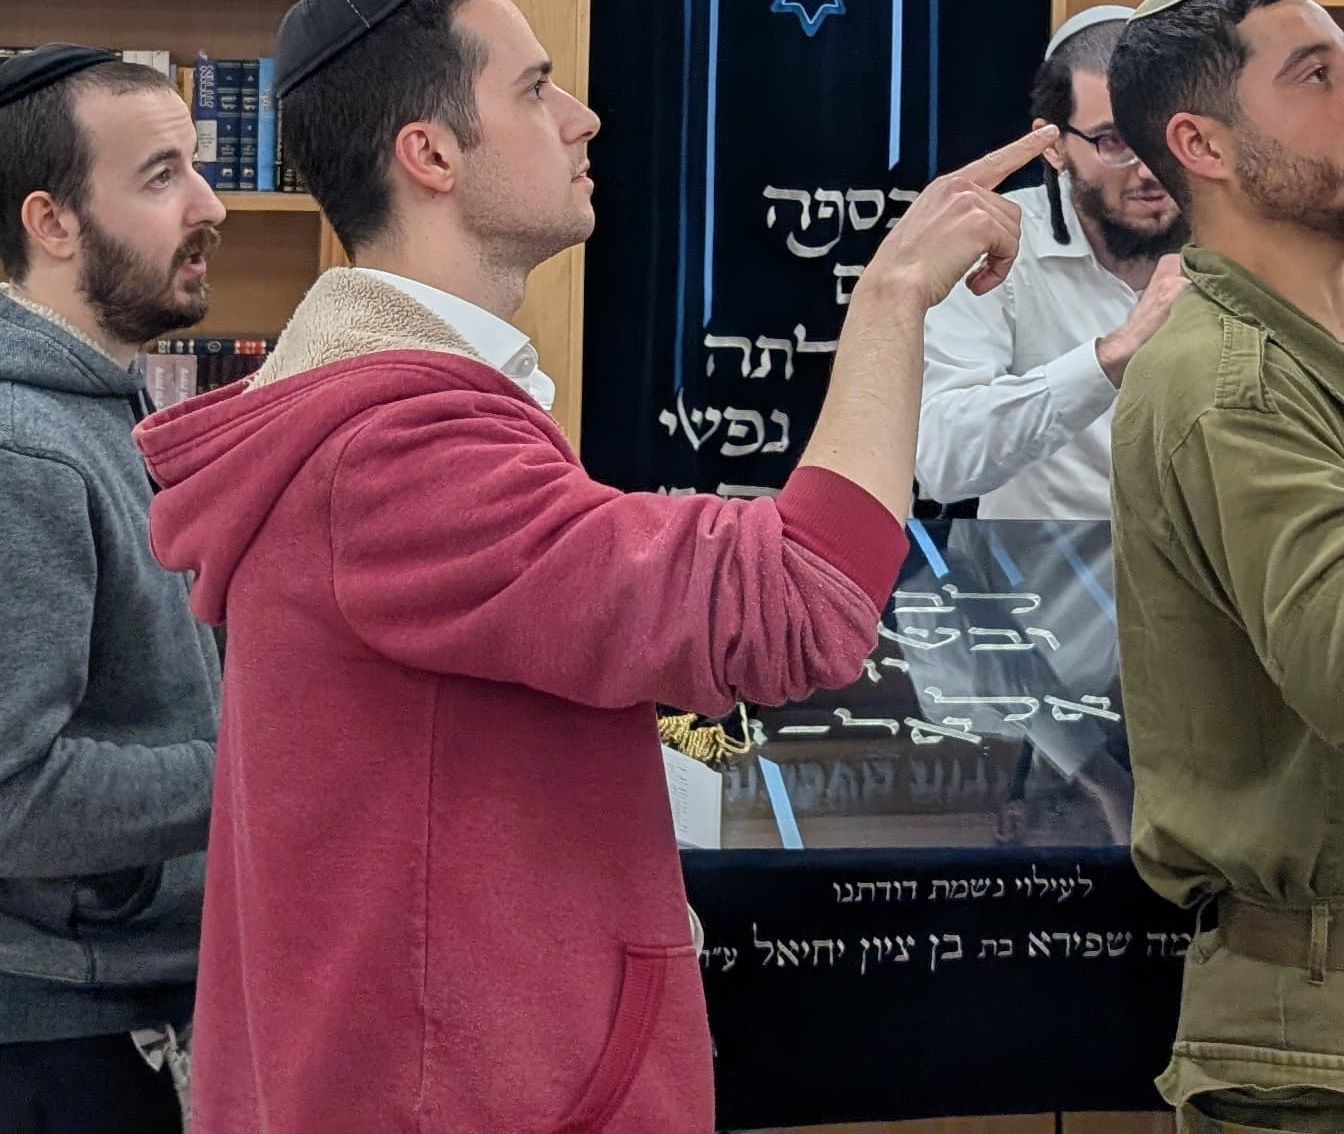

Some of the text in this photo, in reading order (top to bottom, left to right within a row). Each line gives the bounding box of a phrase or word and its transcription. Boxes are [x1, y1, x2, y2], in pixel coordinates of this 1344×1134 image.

[658, 387, 789, 458] נפשי
[833, 864, 1094, 904] לעילוי נשמת דודתנו
[753, 921, 846, 967] יחיאל
[860, 934, 916, 976] ציון
[929, 933, 962, 973] בן
[977, 937, 1015, 959] בת
[1028, 930, 1134, 958] שפירא
